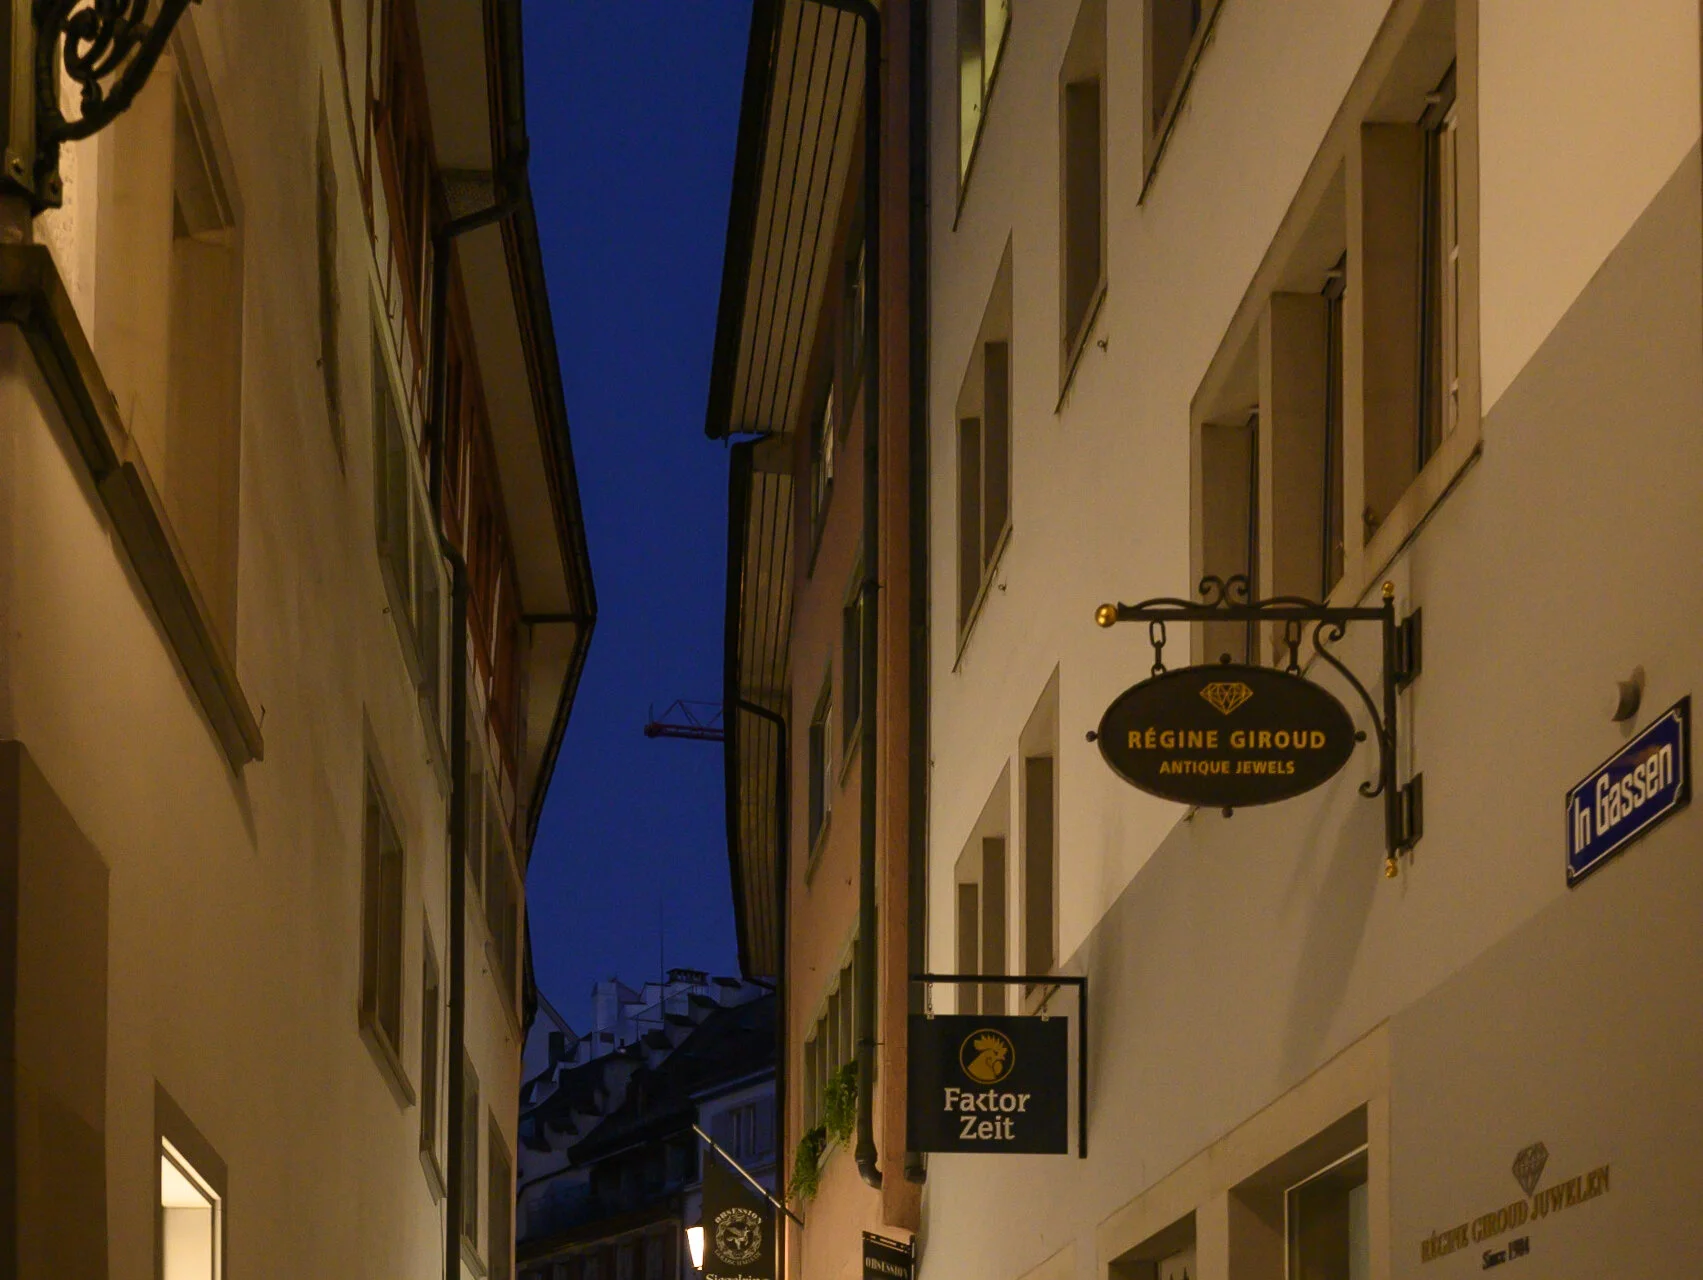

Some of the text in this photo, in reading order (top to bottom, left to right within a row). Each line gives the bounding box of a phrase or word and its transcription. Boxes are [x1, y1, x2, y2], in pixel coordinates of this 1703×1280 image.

[1128, 727, 1326, 749] RÉGINE GIROUD
[1159, 760, 1295, 775] ANTIQUE JEWELS
[1574, 743, 1673, 854] In Gassen
[959, 1116, 1016, 1140] Zeit
[1472, 1199, 1529, 1243] GIROUD
[1531, 1163, 1609, 1221] JUWELEN
